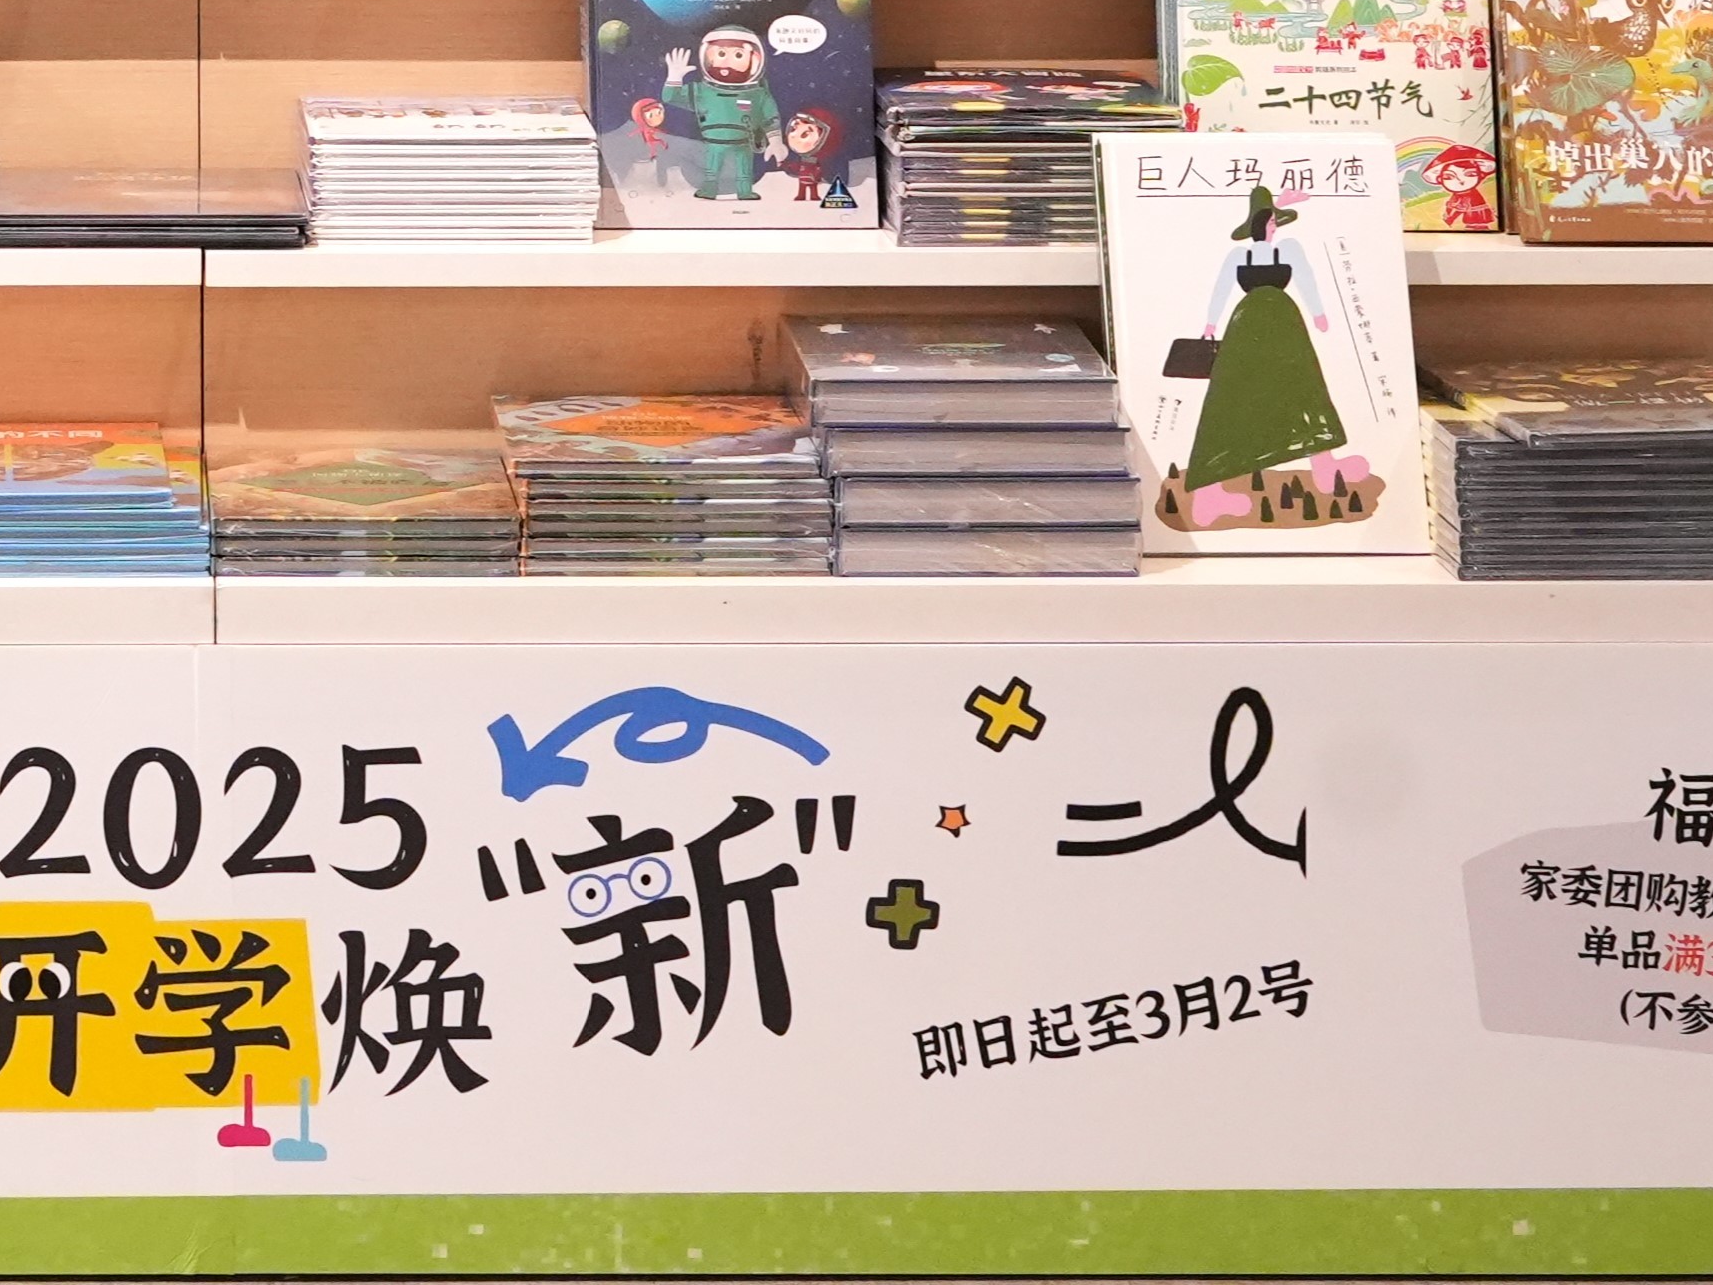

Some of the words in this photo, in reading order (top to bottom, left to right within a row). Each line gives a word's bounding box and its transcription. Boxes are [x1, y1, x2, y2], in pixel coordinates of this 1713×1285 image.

[1257, 81, 1434, 120] 二十四节气
[1135, 154, 1371, 196] 巨人玛丽德
[913, 958, 1314, 1082] 即日起至3月2号
